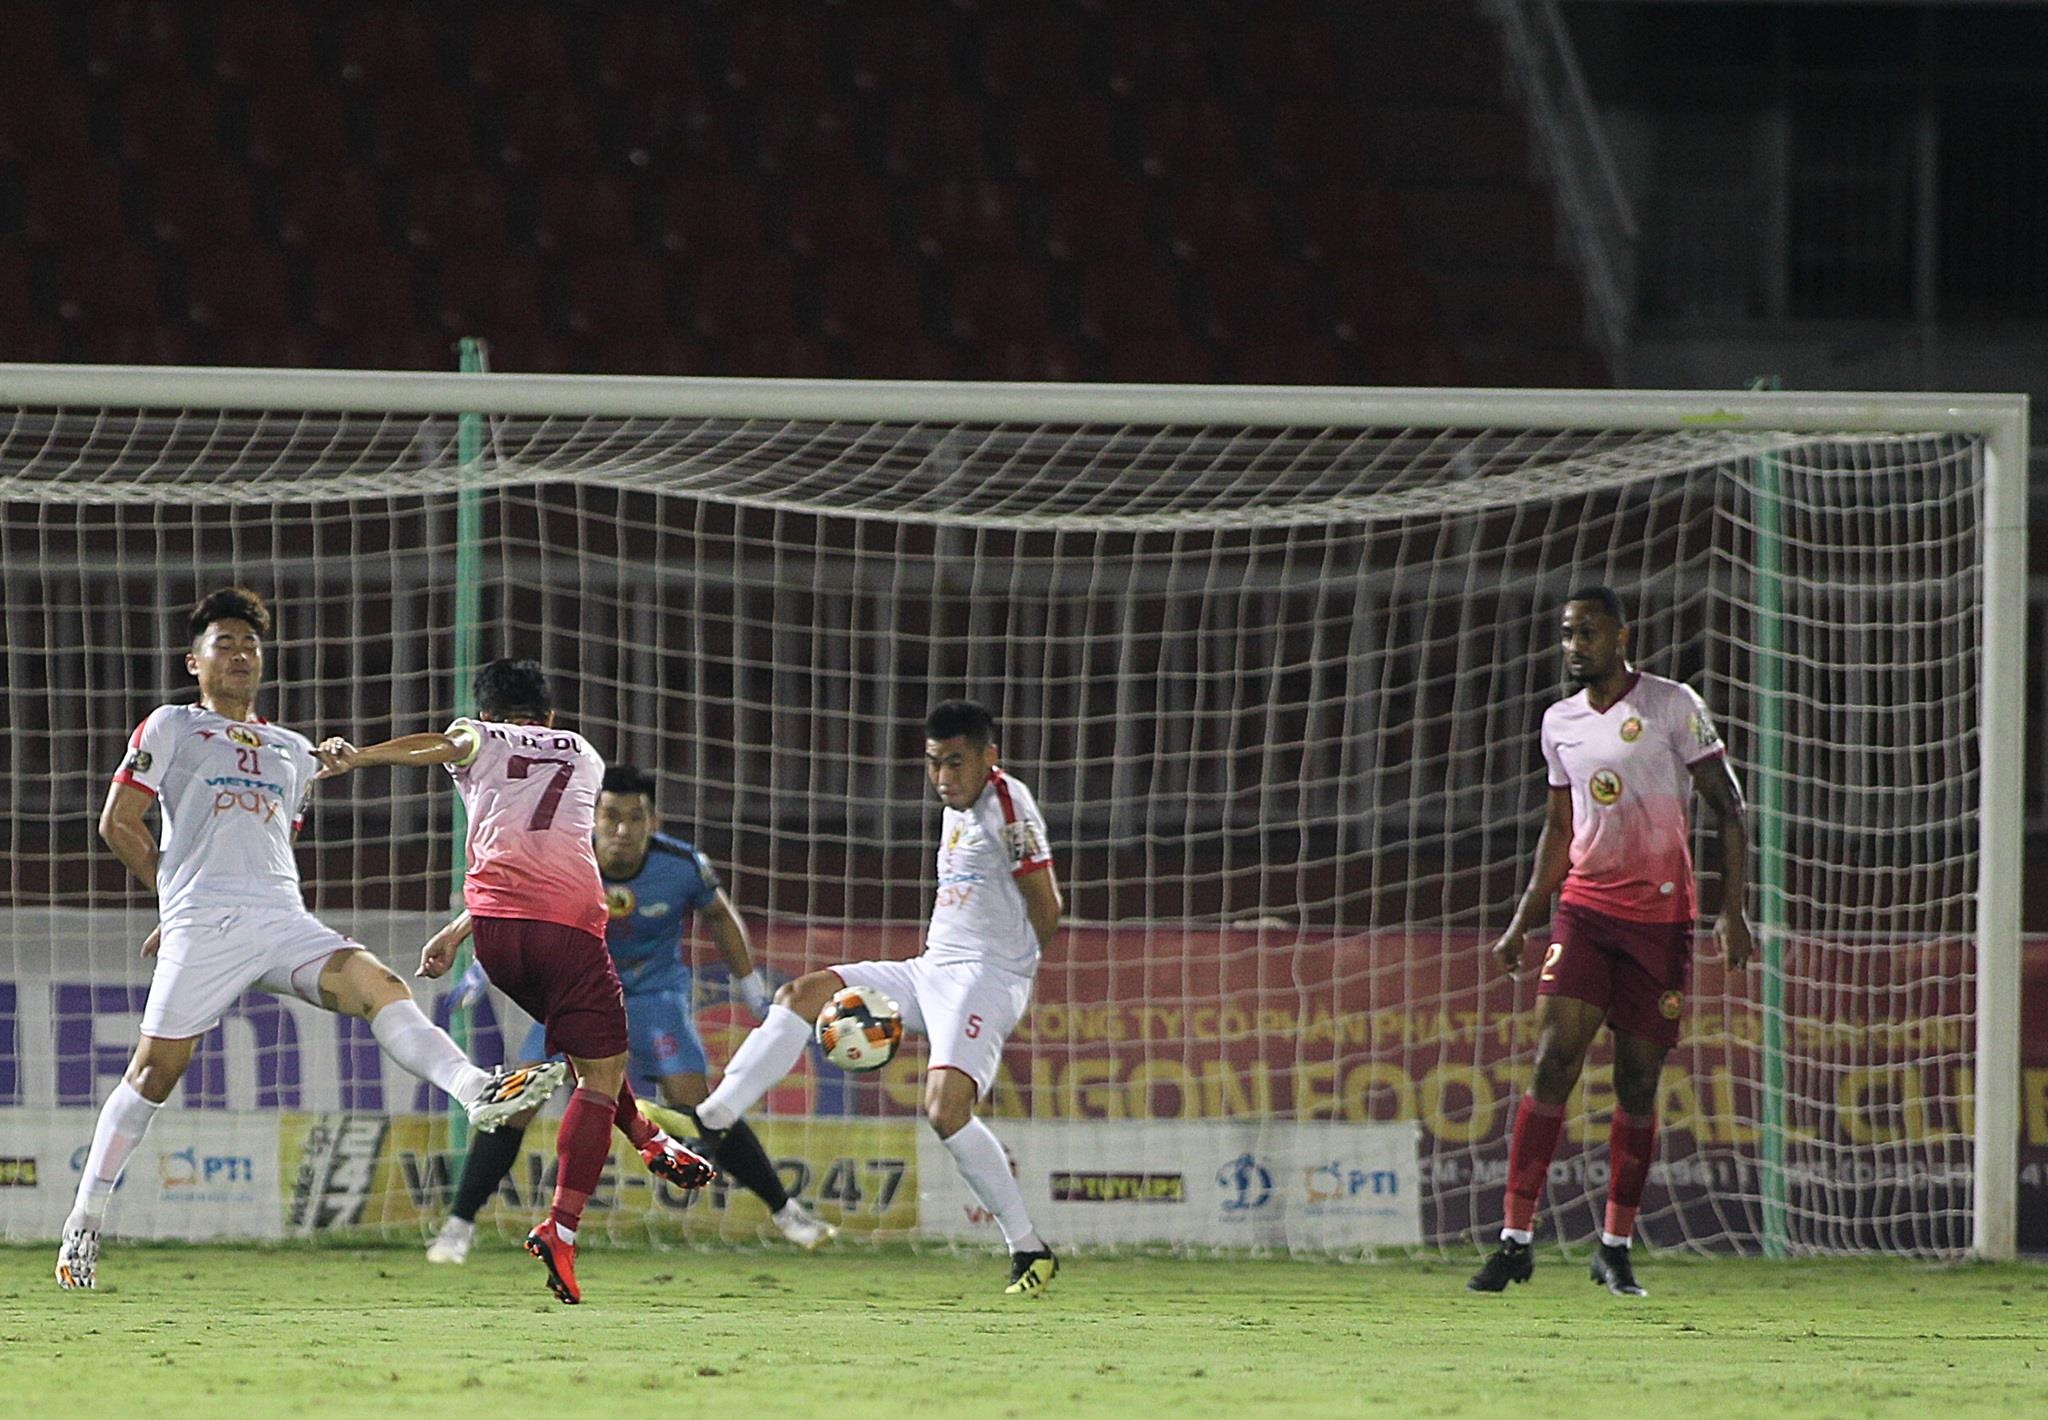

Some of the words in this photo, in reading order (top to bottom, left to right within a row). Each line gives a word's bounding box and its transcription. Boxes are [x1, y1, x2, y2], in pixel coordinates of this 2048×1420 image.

[235, 747, 262, 775] 21
[214, 789, 280, 824] pay
[506, 754, 576, 832] 7
[1540, 943, 1563, 981] 2
[964, 1012, 985, 1040] 5
[771, 1157, 906, 1211] 247
